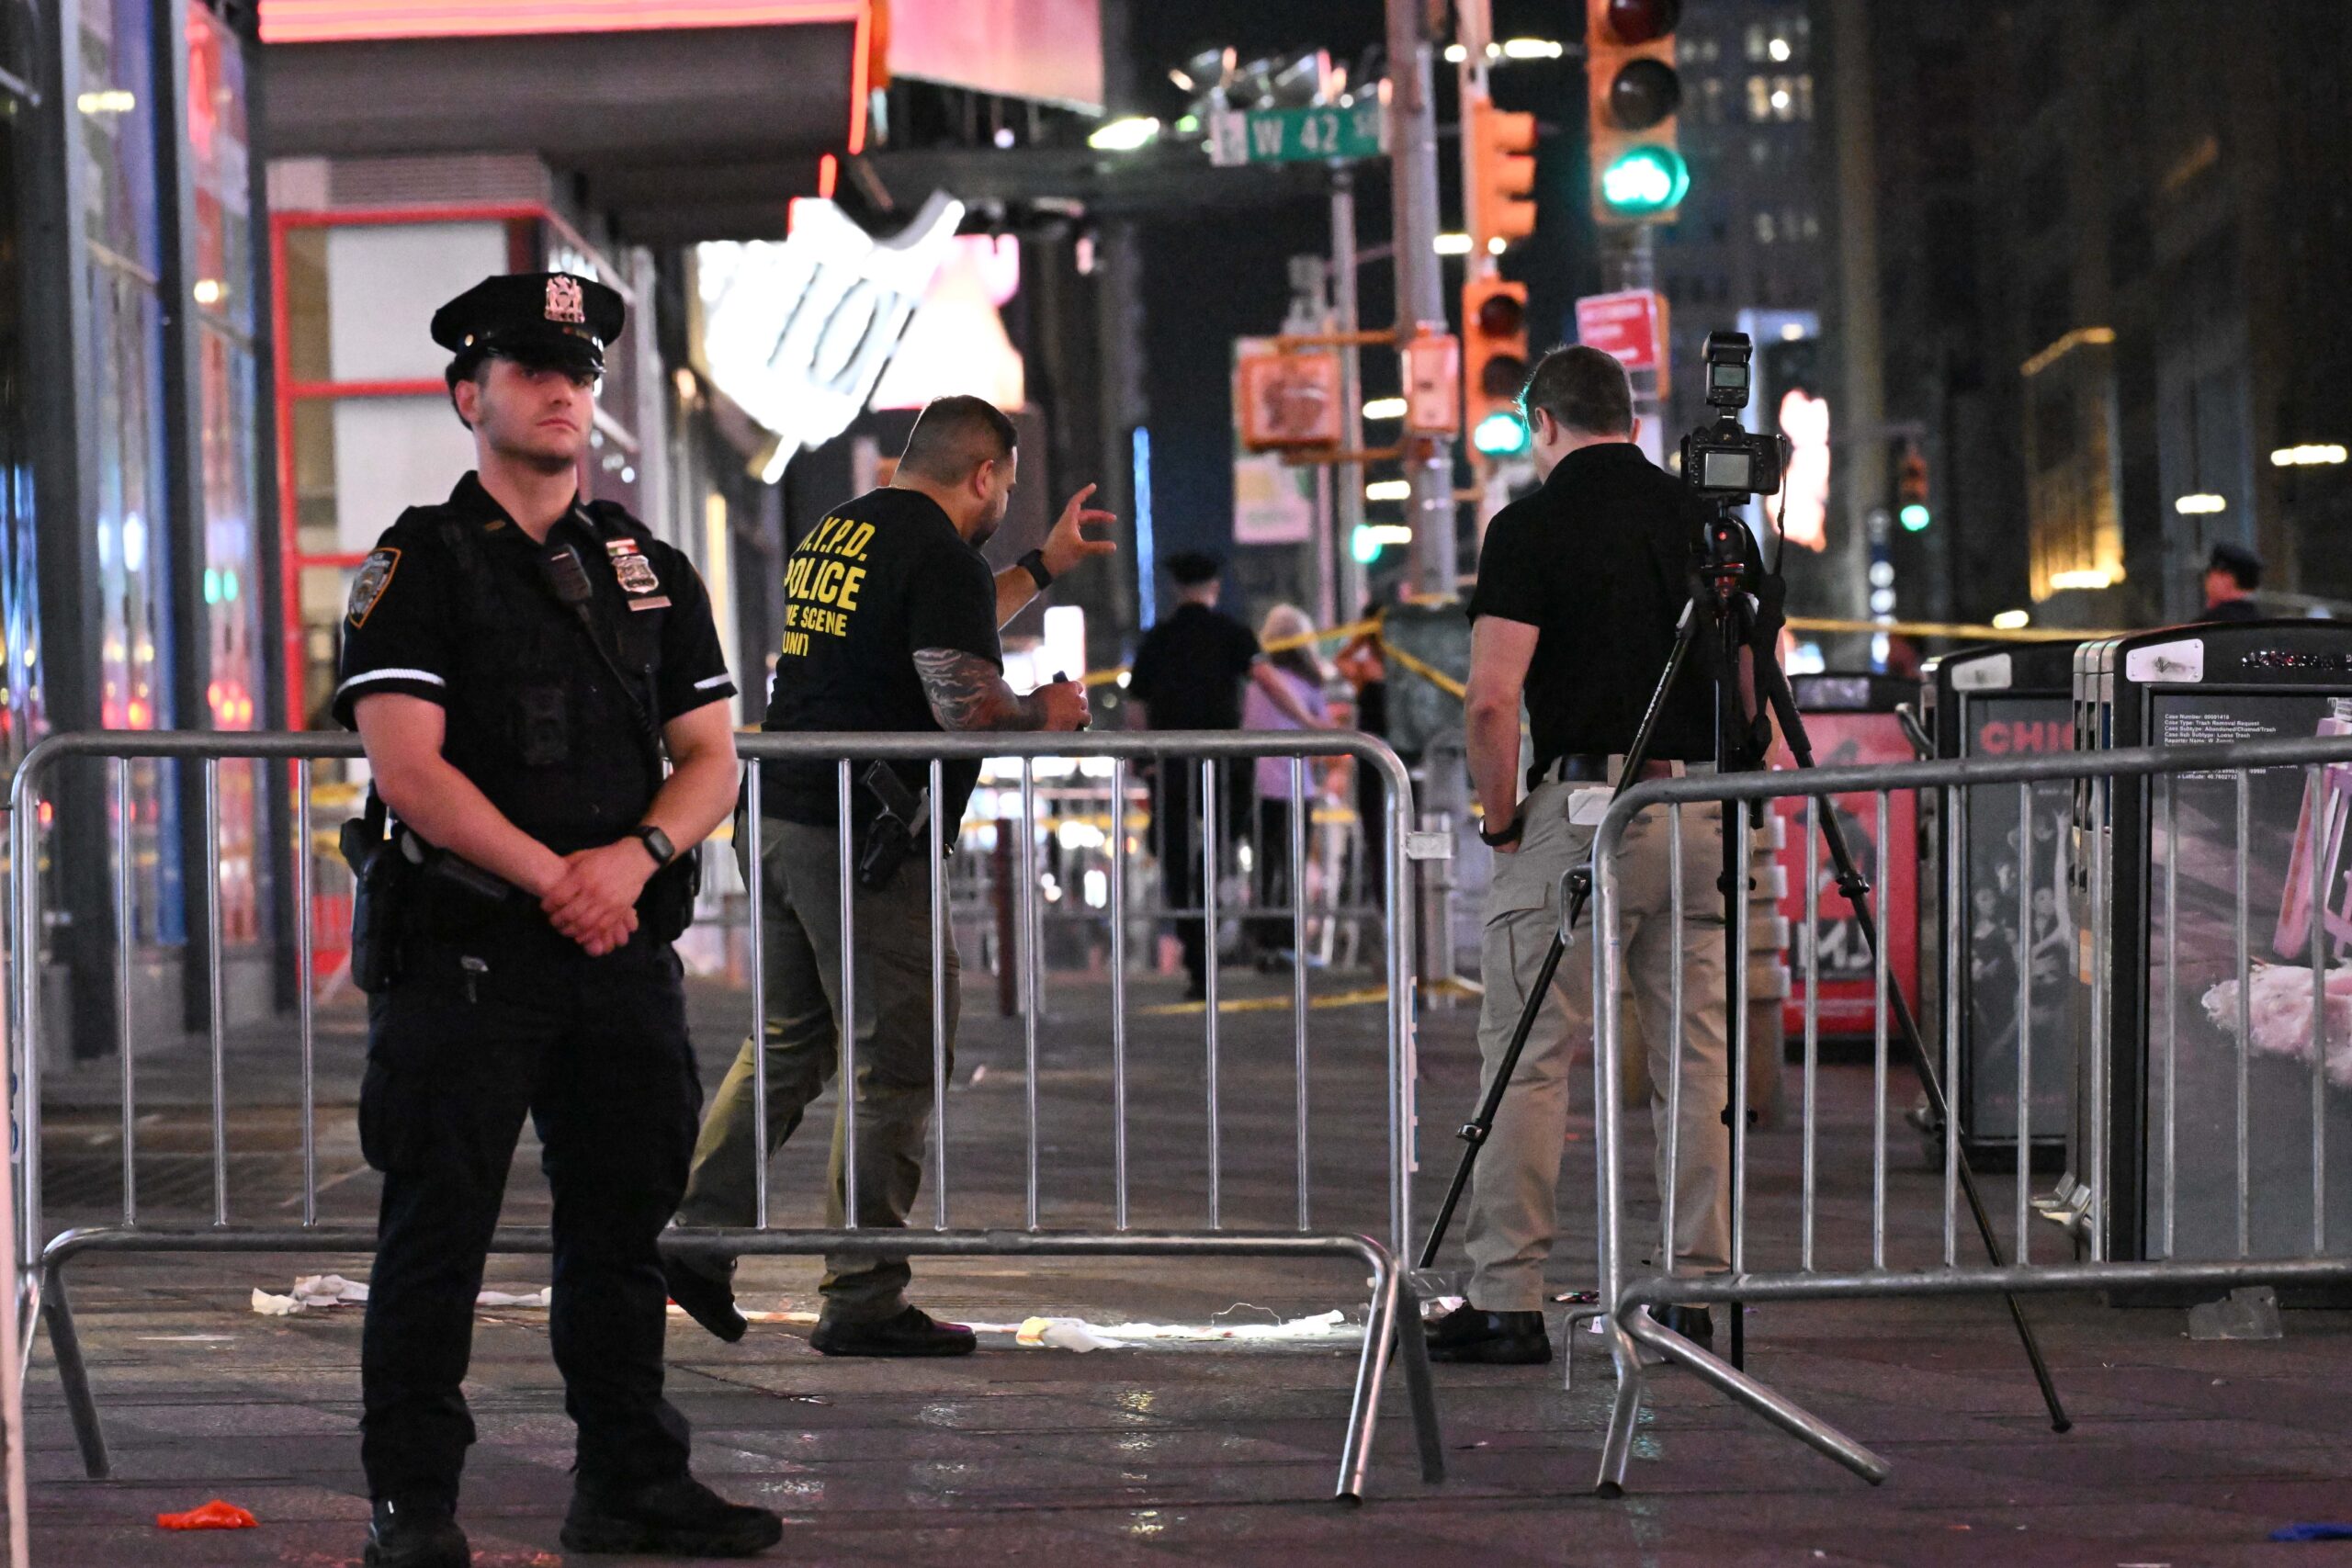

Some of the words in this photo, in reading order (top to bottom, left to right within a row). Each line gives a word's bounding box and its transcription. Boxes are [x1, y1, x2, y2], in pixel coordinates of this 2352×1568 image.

[1252, 118, 1284, 154] W
[1300, 114, 1339, 152] 42
[800, 606, 848, 637] SCENE
[782, 631, 809, 657] UNIT
